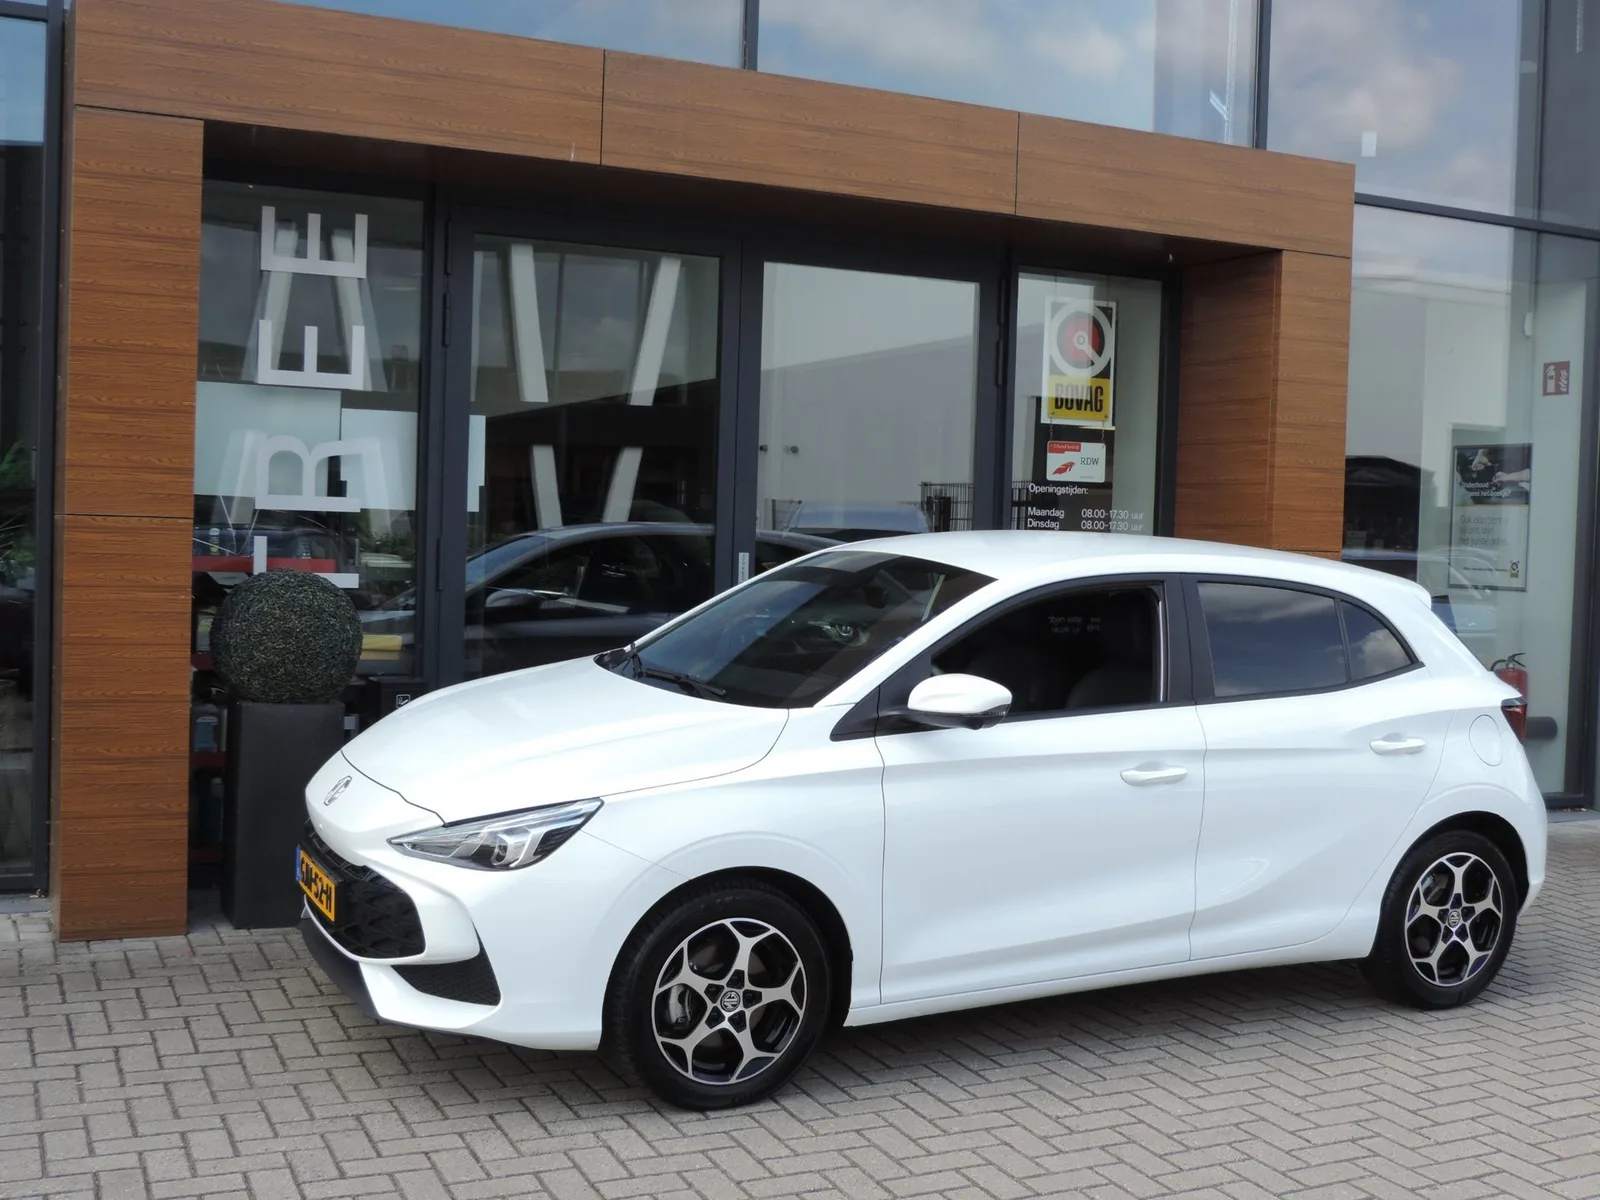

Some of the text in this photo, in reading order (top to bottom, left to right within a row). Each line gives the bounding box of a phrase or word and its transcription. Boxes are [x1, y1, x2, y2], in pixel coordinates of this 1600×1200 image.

[1054, 383, 1104, 413] BOVAG
[1080, 456, 1099, 466] RDW
[1028, 483, 1089, 496] Openingstijden:
[1027, 507, 1065, 519] Maandag
[1081, 508, 1129, 520] 08.00-17.30
[1027, 518, 1060, 530] Dinsdag
[1080, 520, 1129, 531] 08.00-17.30
